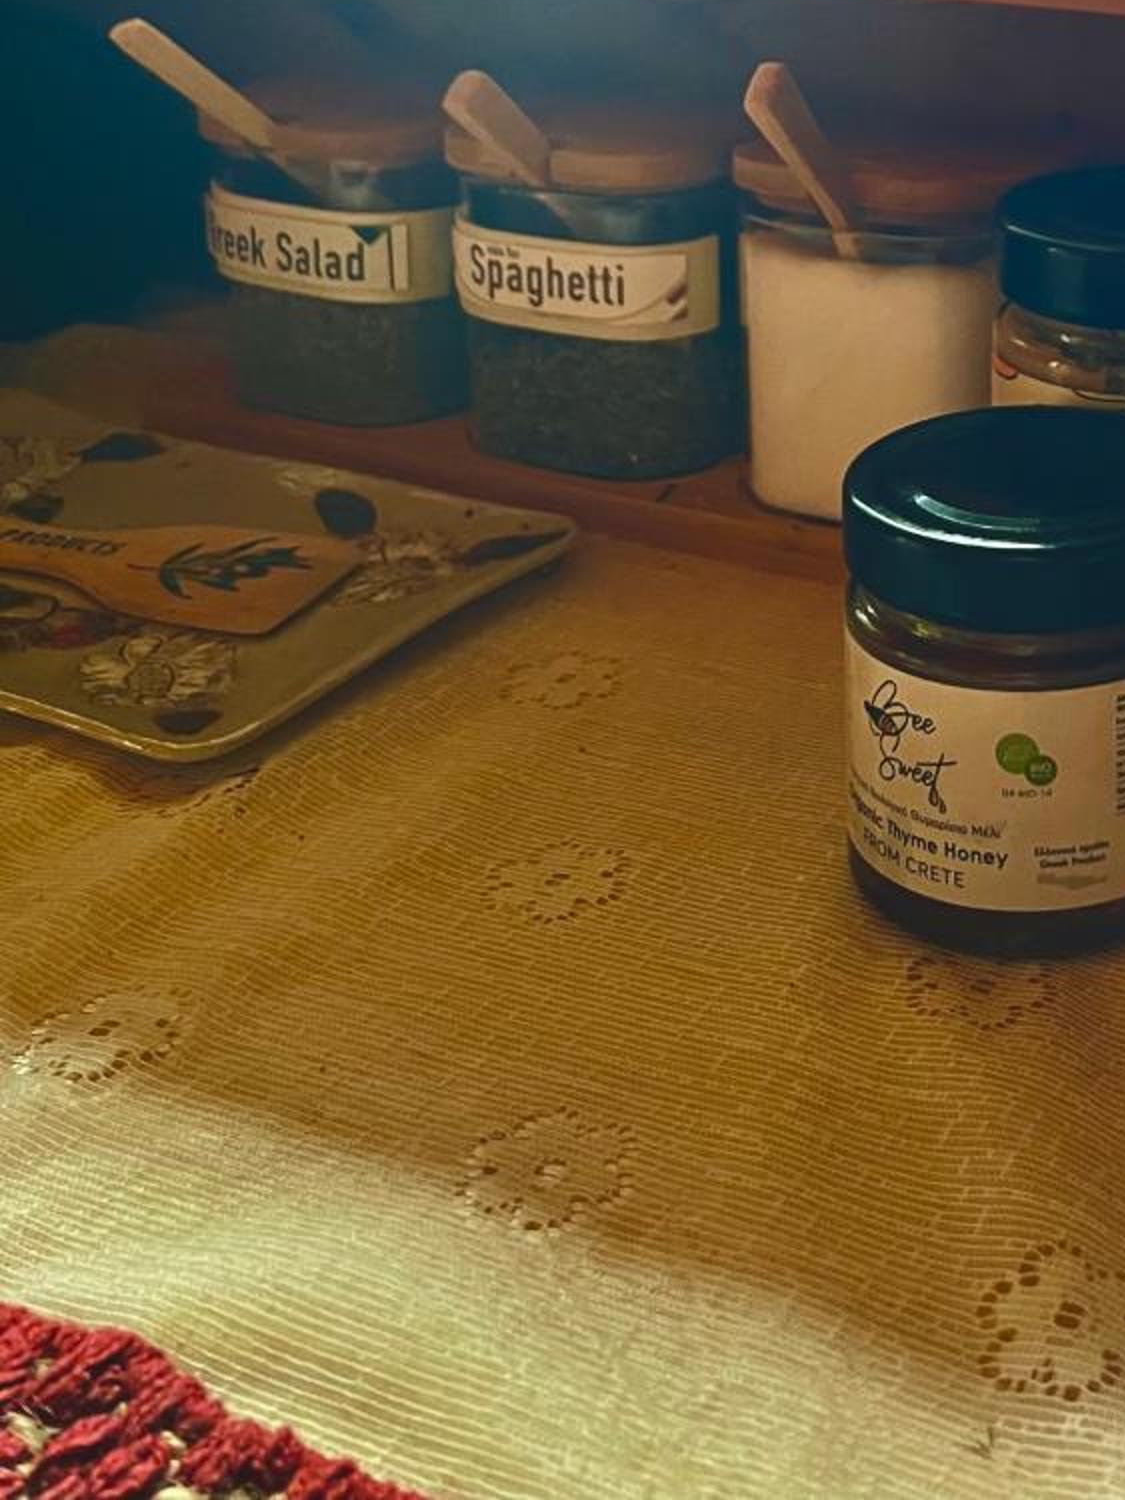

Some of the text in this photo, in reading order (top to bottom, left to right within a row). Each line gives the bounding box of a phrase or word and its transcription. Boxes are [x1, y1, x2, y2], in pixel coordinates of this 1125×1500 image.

[210, 225, 365, 281] reek Salad
[471, 244, 625, 307] Spaghetti
[868, 679, 938, 736] Bee
[879, 736, 957, 813] Sweet
[863, 826, 967, 889] FROM CRETE
[888, 819, 938, 855] Thyme
[944, 841, 1009, 870] Honey
